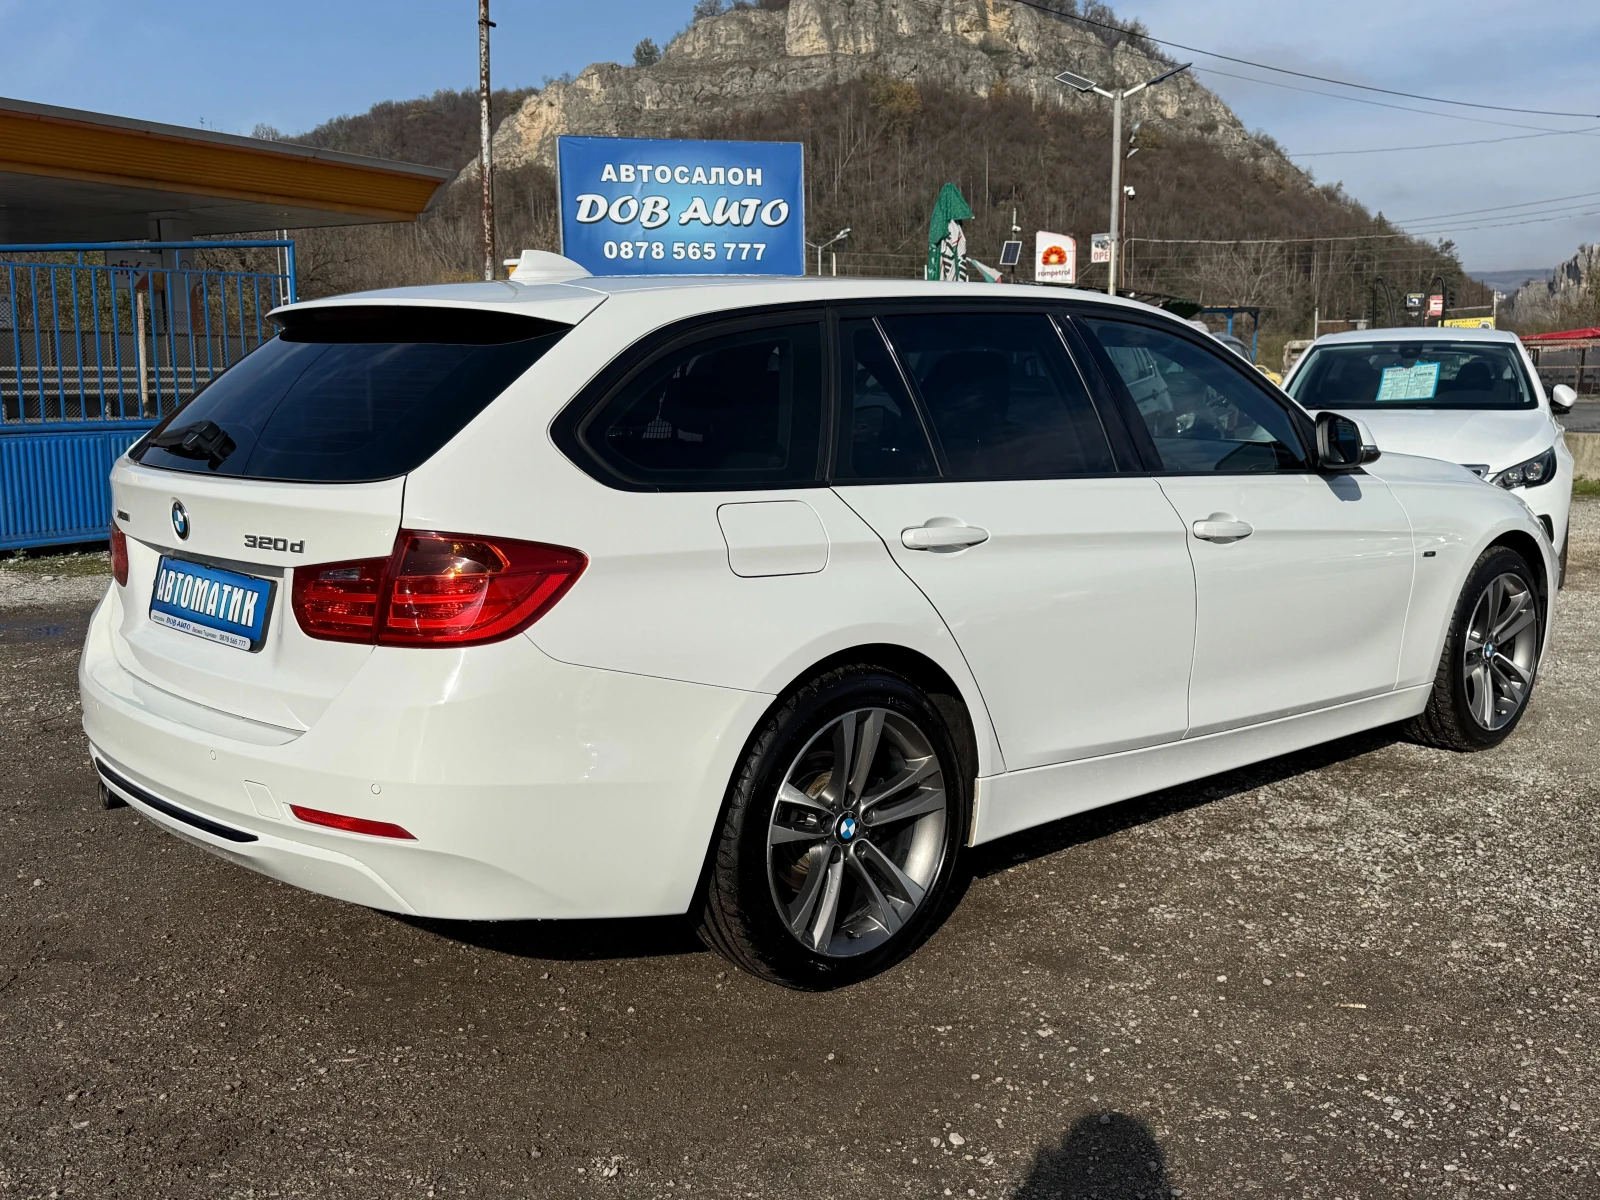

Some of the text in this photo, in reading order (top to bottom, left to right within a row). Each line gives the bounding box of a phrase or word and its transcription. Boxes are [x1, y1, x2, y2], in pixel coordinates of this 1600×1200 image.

[600, 163, 763, 186] АВТОСАЛОН
[575, 194, 790, 229] DOB AUTO
[603, 241, 766, 261] 0878 565 777
[1037, 269, 1071, 278] rompetrol
[156, 568, 259, 628] АВТОМАТИК
